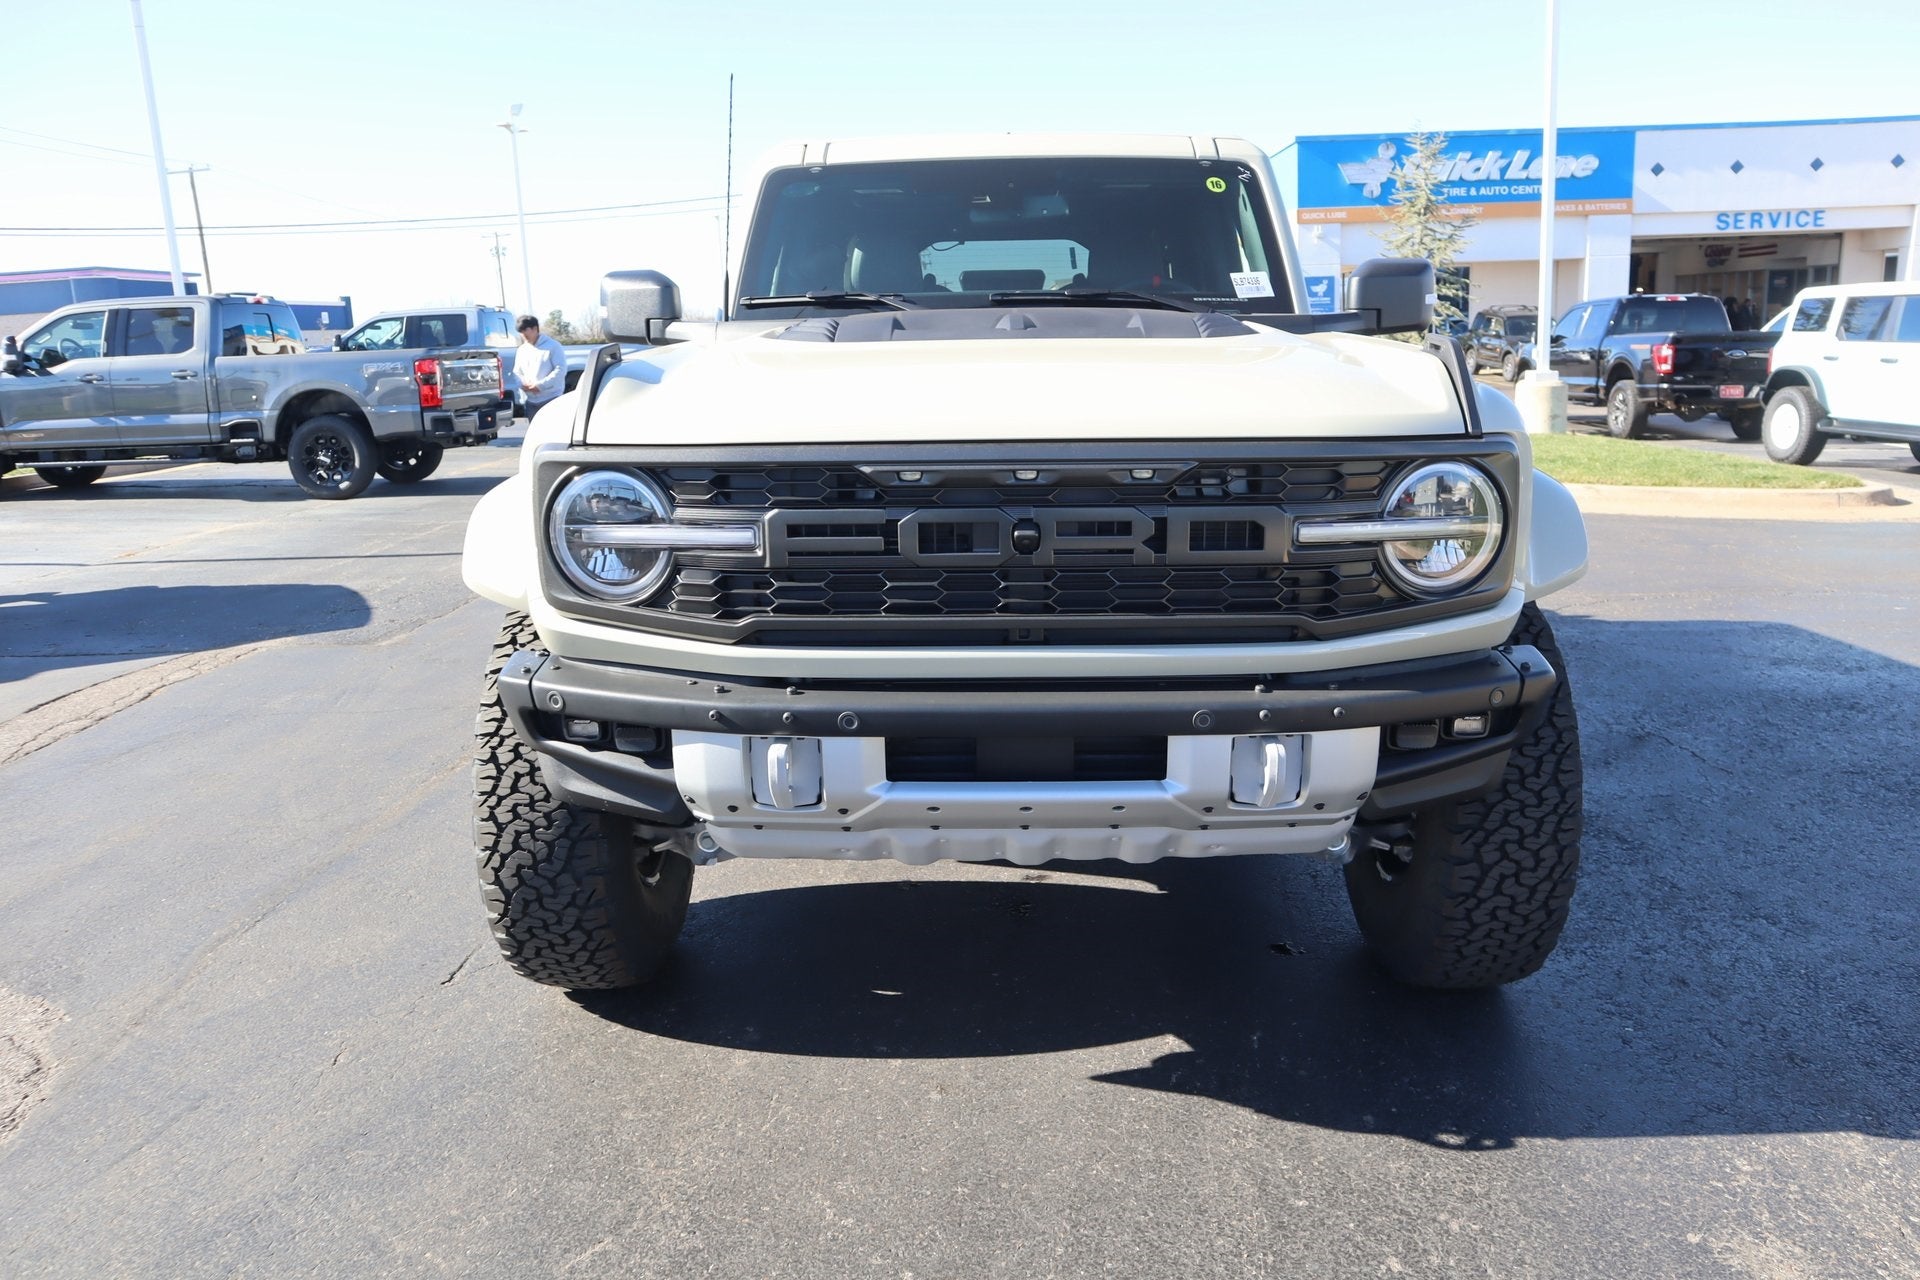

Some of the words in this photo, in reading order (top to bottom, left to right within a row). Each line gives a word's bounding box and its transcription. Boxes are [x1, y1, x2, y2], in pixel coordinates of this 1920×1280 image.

[1210, 180, 1222, 189] 16
[1444, 187, 1467, 196] TIRE
[1469, 187, 1477, 196] &
[1479, 185, 1509, 195] AUTO
[1511, 185, 1542, 195] CENT
[1585, 202, 1628, 211] BATTERIES
[1716, 209, 1826, 231] SERVICE
[764, 505, 1291, 567] FORD
